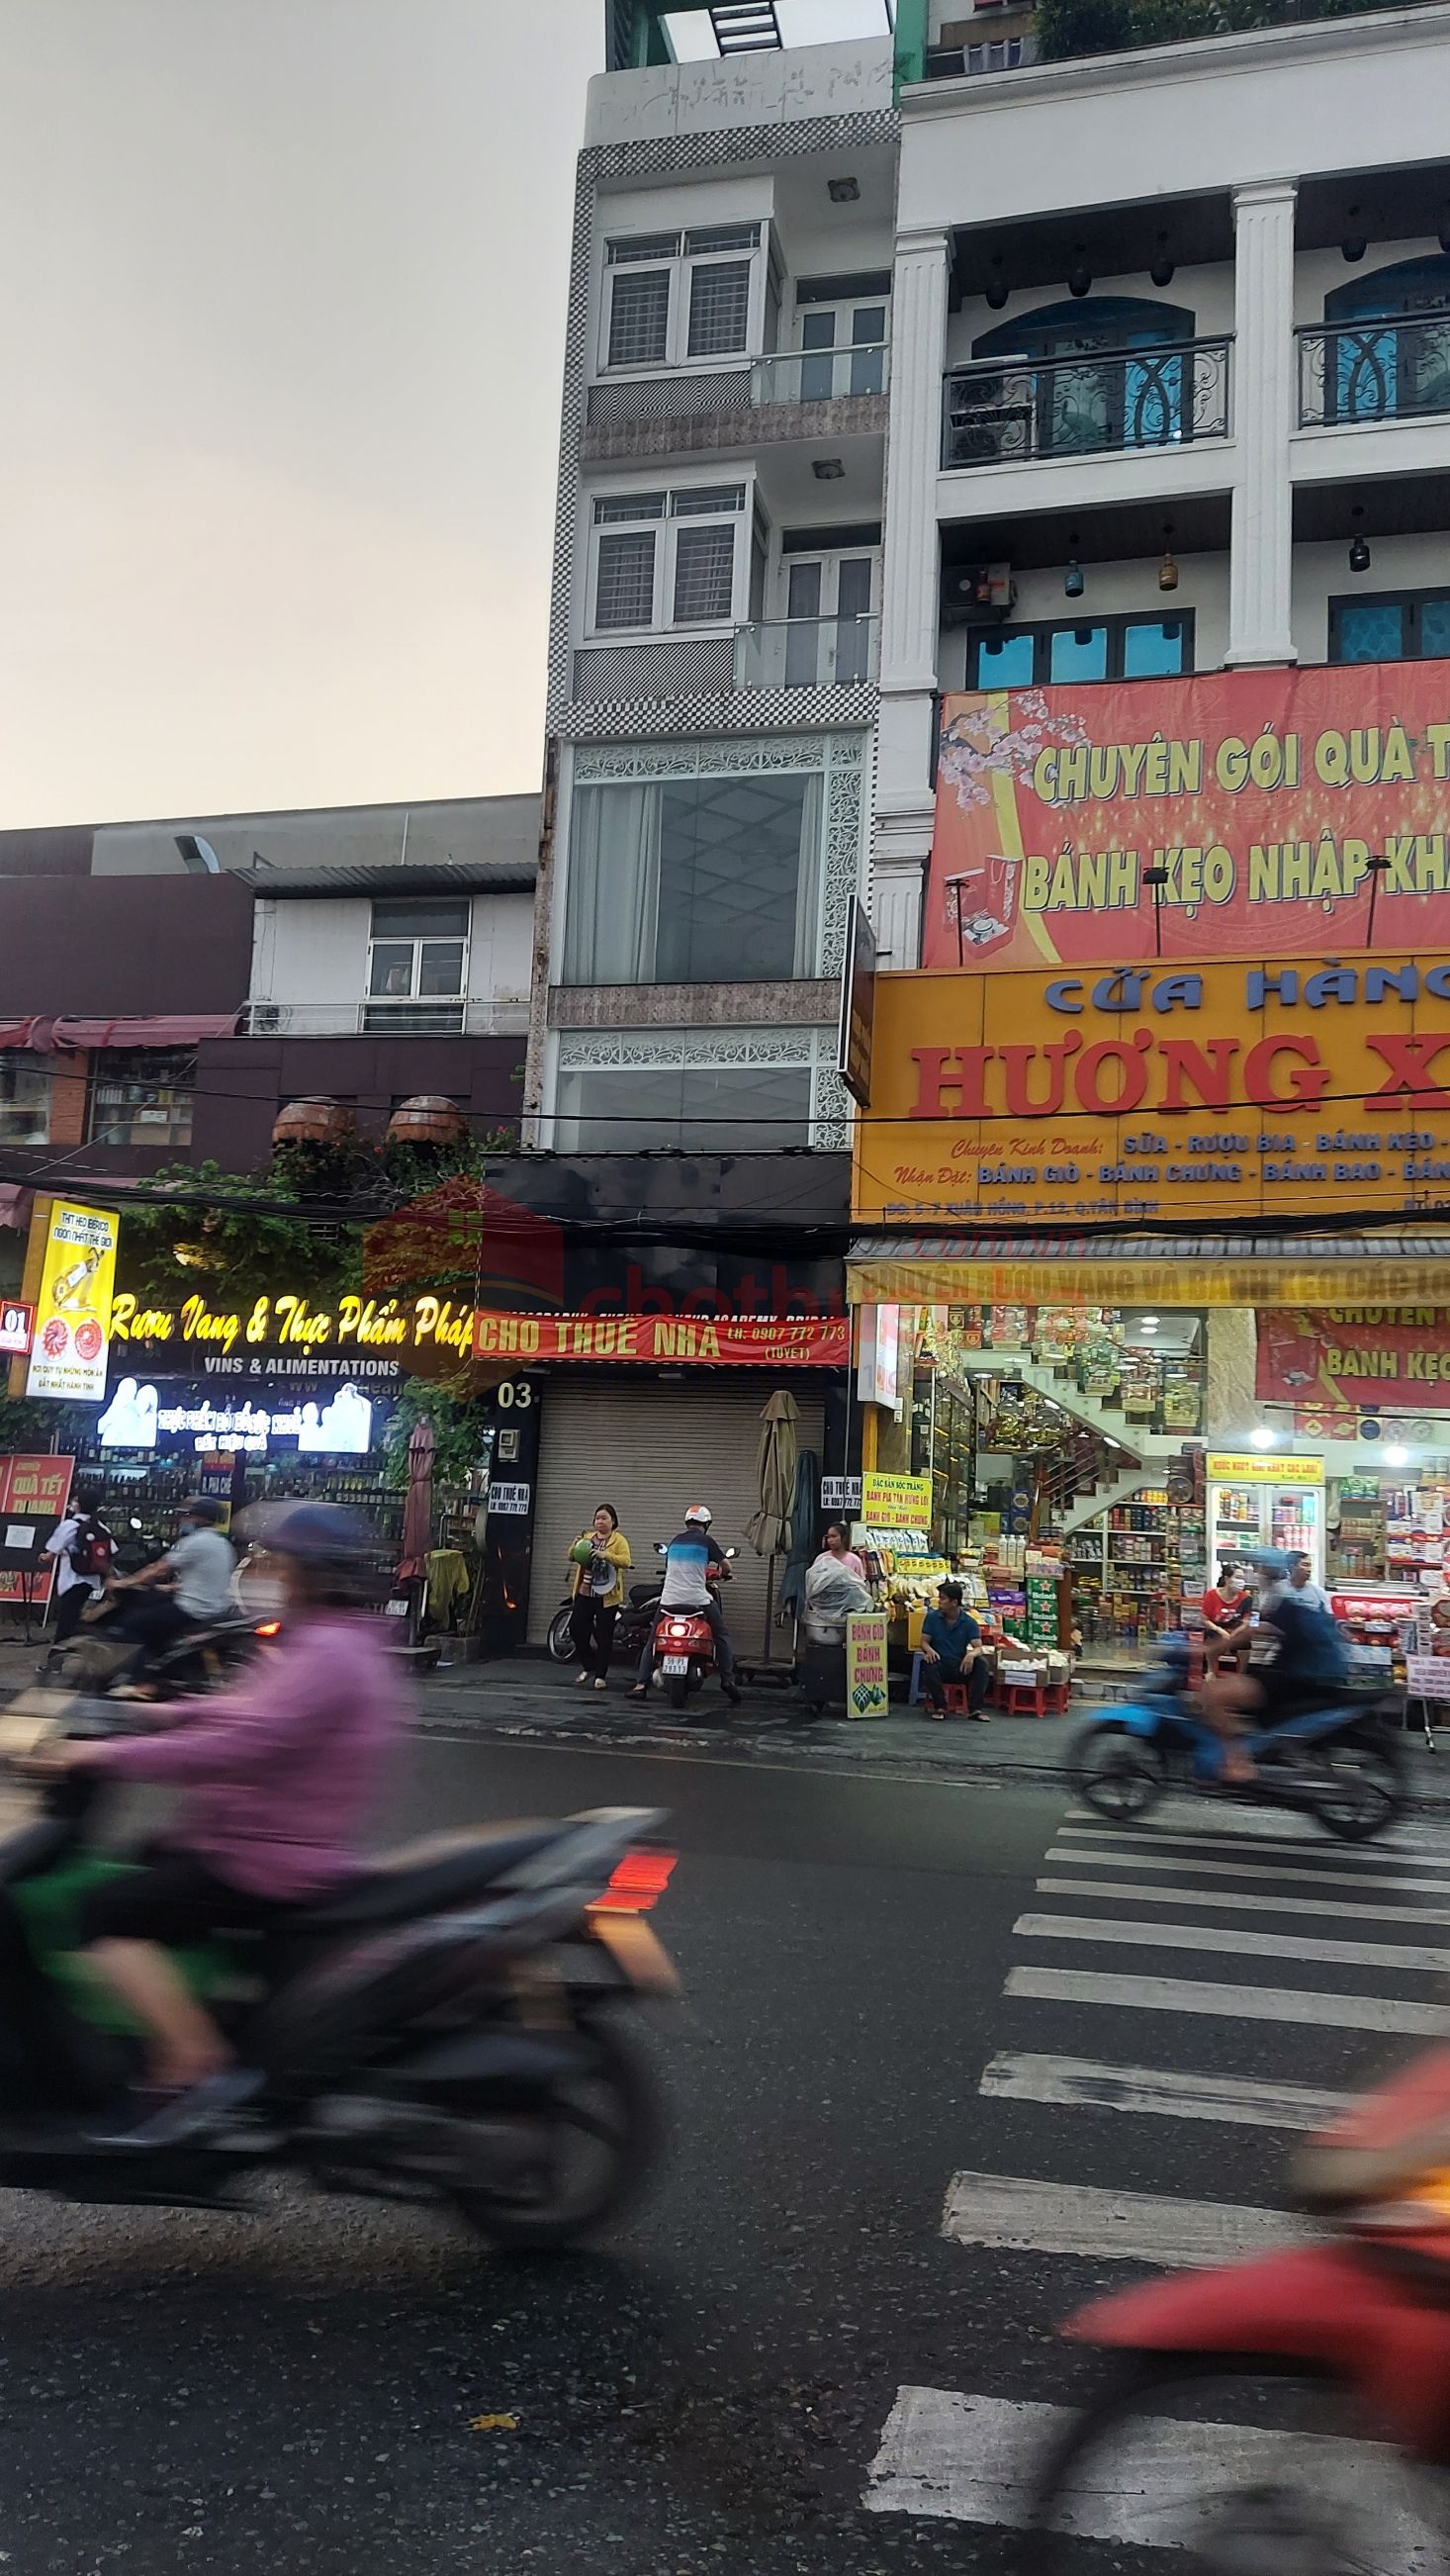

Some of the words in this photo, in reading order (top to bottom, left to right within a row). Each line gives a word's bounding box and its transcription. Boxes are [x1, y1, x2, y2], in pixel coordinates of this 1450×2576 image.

[1033, 731, 1202, 804] CHUYÊN
[1216, 721, 1300, 791] GÓI
[1314, 715, 1417, 790] QUÀ
[1023, 841, 1139, 912] BÁNH
[1154, 846, 1235, 919] KẸO
[1248, 828, 1372, 915] NHẬP
[1384, 833, 1450, 896] KH
[1044, 966, 1204, 1015] CỬA
[909, 1027, 1331, 1120] HƯƠNG
[951, 1138, 1005, 1159] Chuyên
[1050, 1137, 1104, 1155] Doanh:
[1124, 1131, 1168, 1153] SỮA
[1188, 1132, 1249, 1159] RƯỢU
[1257, 1133, 1297, 1152] BIA
[1315, 1128, 1381, 1151] BÁNH
[1388, 1131, 1435, 1156] KẸO
[894, 1165, 935, 1186] Nhận
[938, 1166, 972, 1187] Đặt:
[977, 1161, 1037, 1185] BÁNH
[1042, 1160, 1081, 1184] GIÒ
[1098, 1159, 1159, 1183] BÁNH
[1164, 1160, 1243, 1183] CHƯNG
[1262, 1158, 1327, 1181] BÁNH
[1333, 1161, 1382, 1182] BAO
[4, 1309, 26, 1334] 01
[181, 1293, 240, 1355] Vang
[246, 1295, 271, 1343] &
[275, 1294, 331, 1356] Thực
[338, 1294, 408, 1345] Phẩm
[413, 1296, 475, 1358] Pháp
[479, 1317, 540, 1353] CHO
[554, 1317, 639, 1355] THUÊ
[652, 1319, 722, 1358] NHÀ
[752, 1327, 784, 1340] 0907
[790, 1326, 814, 1340] 772
[820, 1325, 845, 1340] 773
[204, 1356, 244, 1374] VINS
[249, 1356, 262, 1375] &
[265, 1357, 400, 1377] ALIMENTATIONS
[498, 1382, 532, 1409] 03
[857, 1642, 880, 1663] BÁNH
